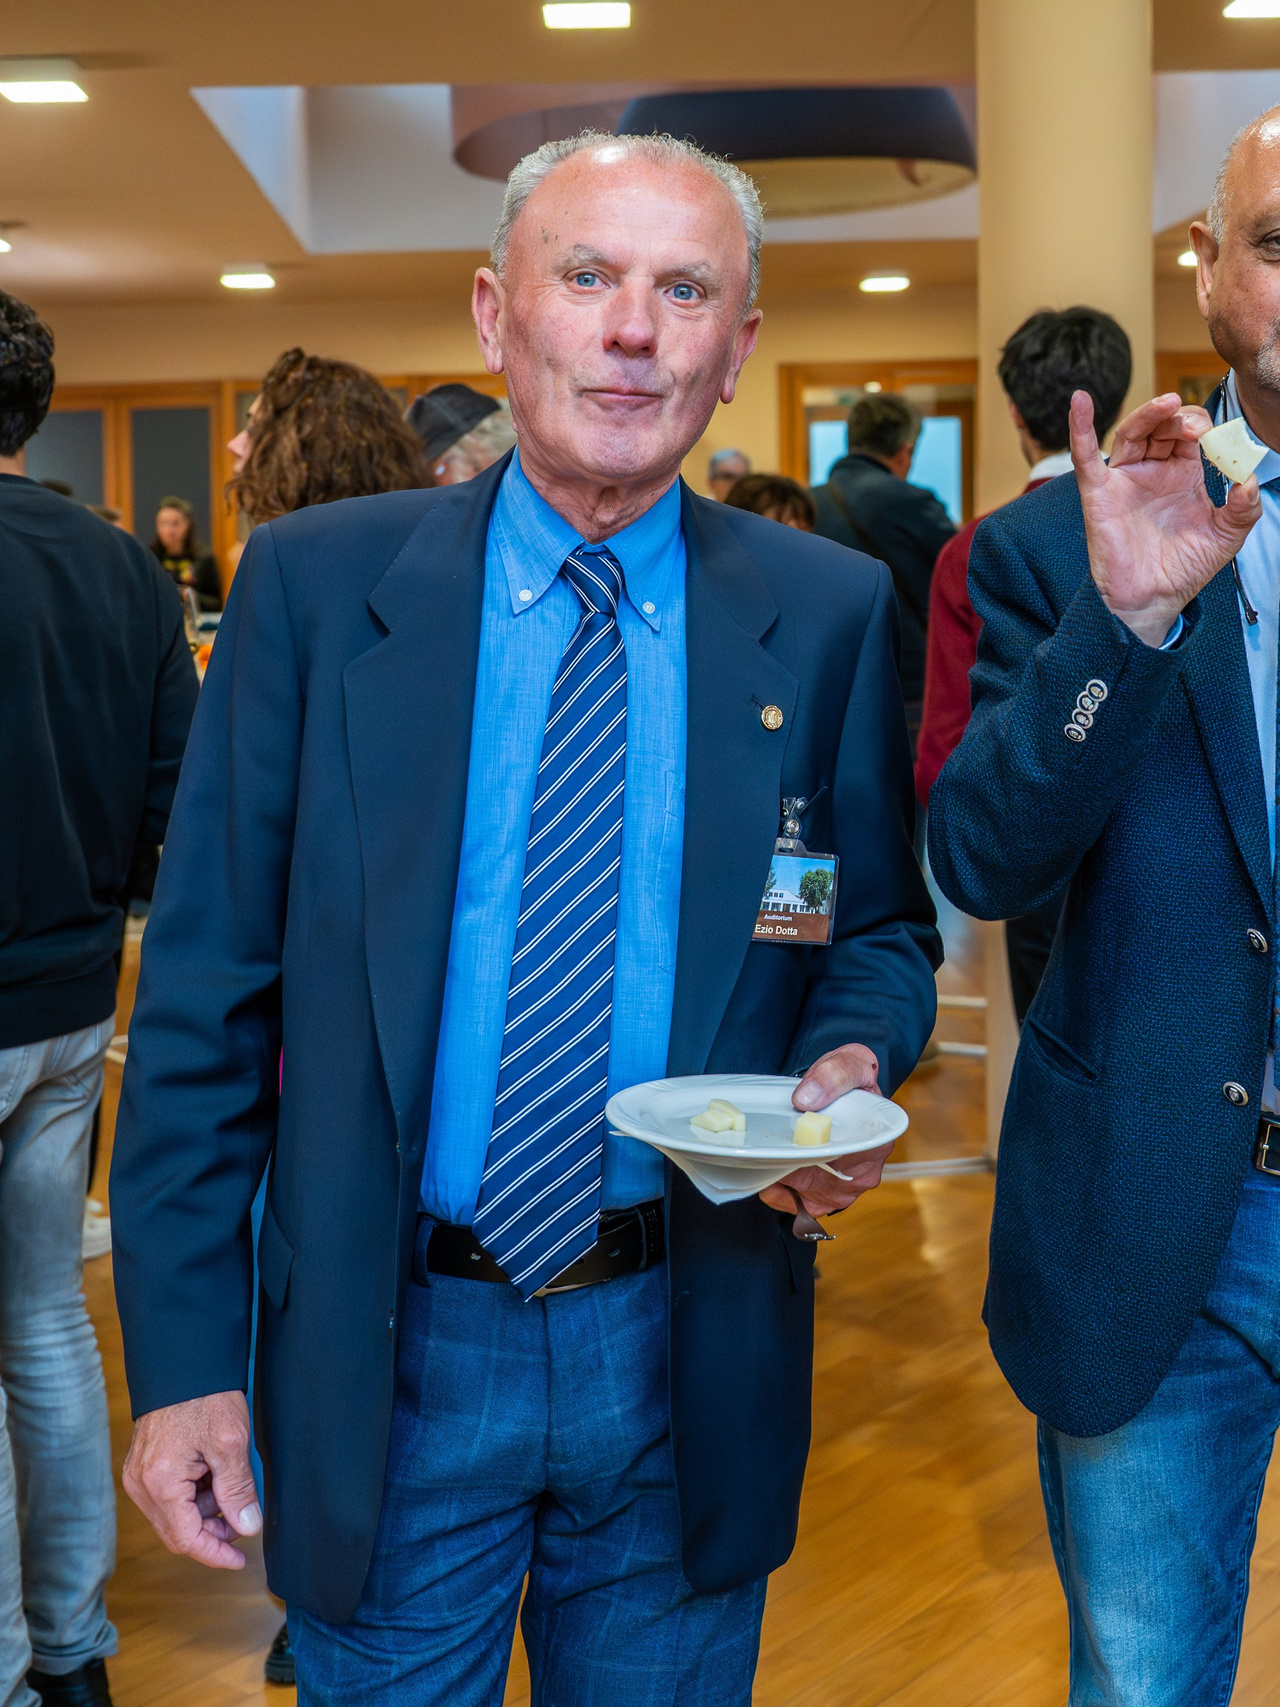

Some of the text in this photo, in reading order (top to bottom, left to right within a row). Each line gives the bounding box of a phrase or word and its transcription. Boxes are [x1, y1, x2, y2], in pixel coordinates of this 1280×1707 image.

[763, 913, 793, 921] Auditorium
[755, 924, 798, 936] Ezio Dotta
